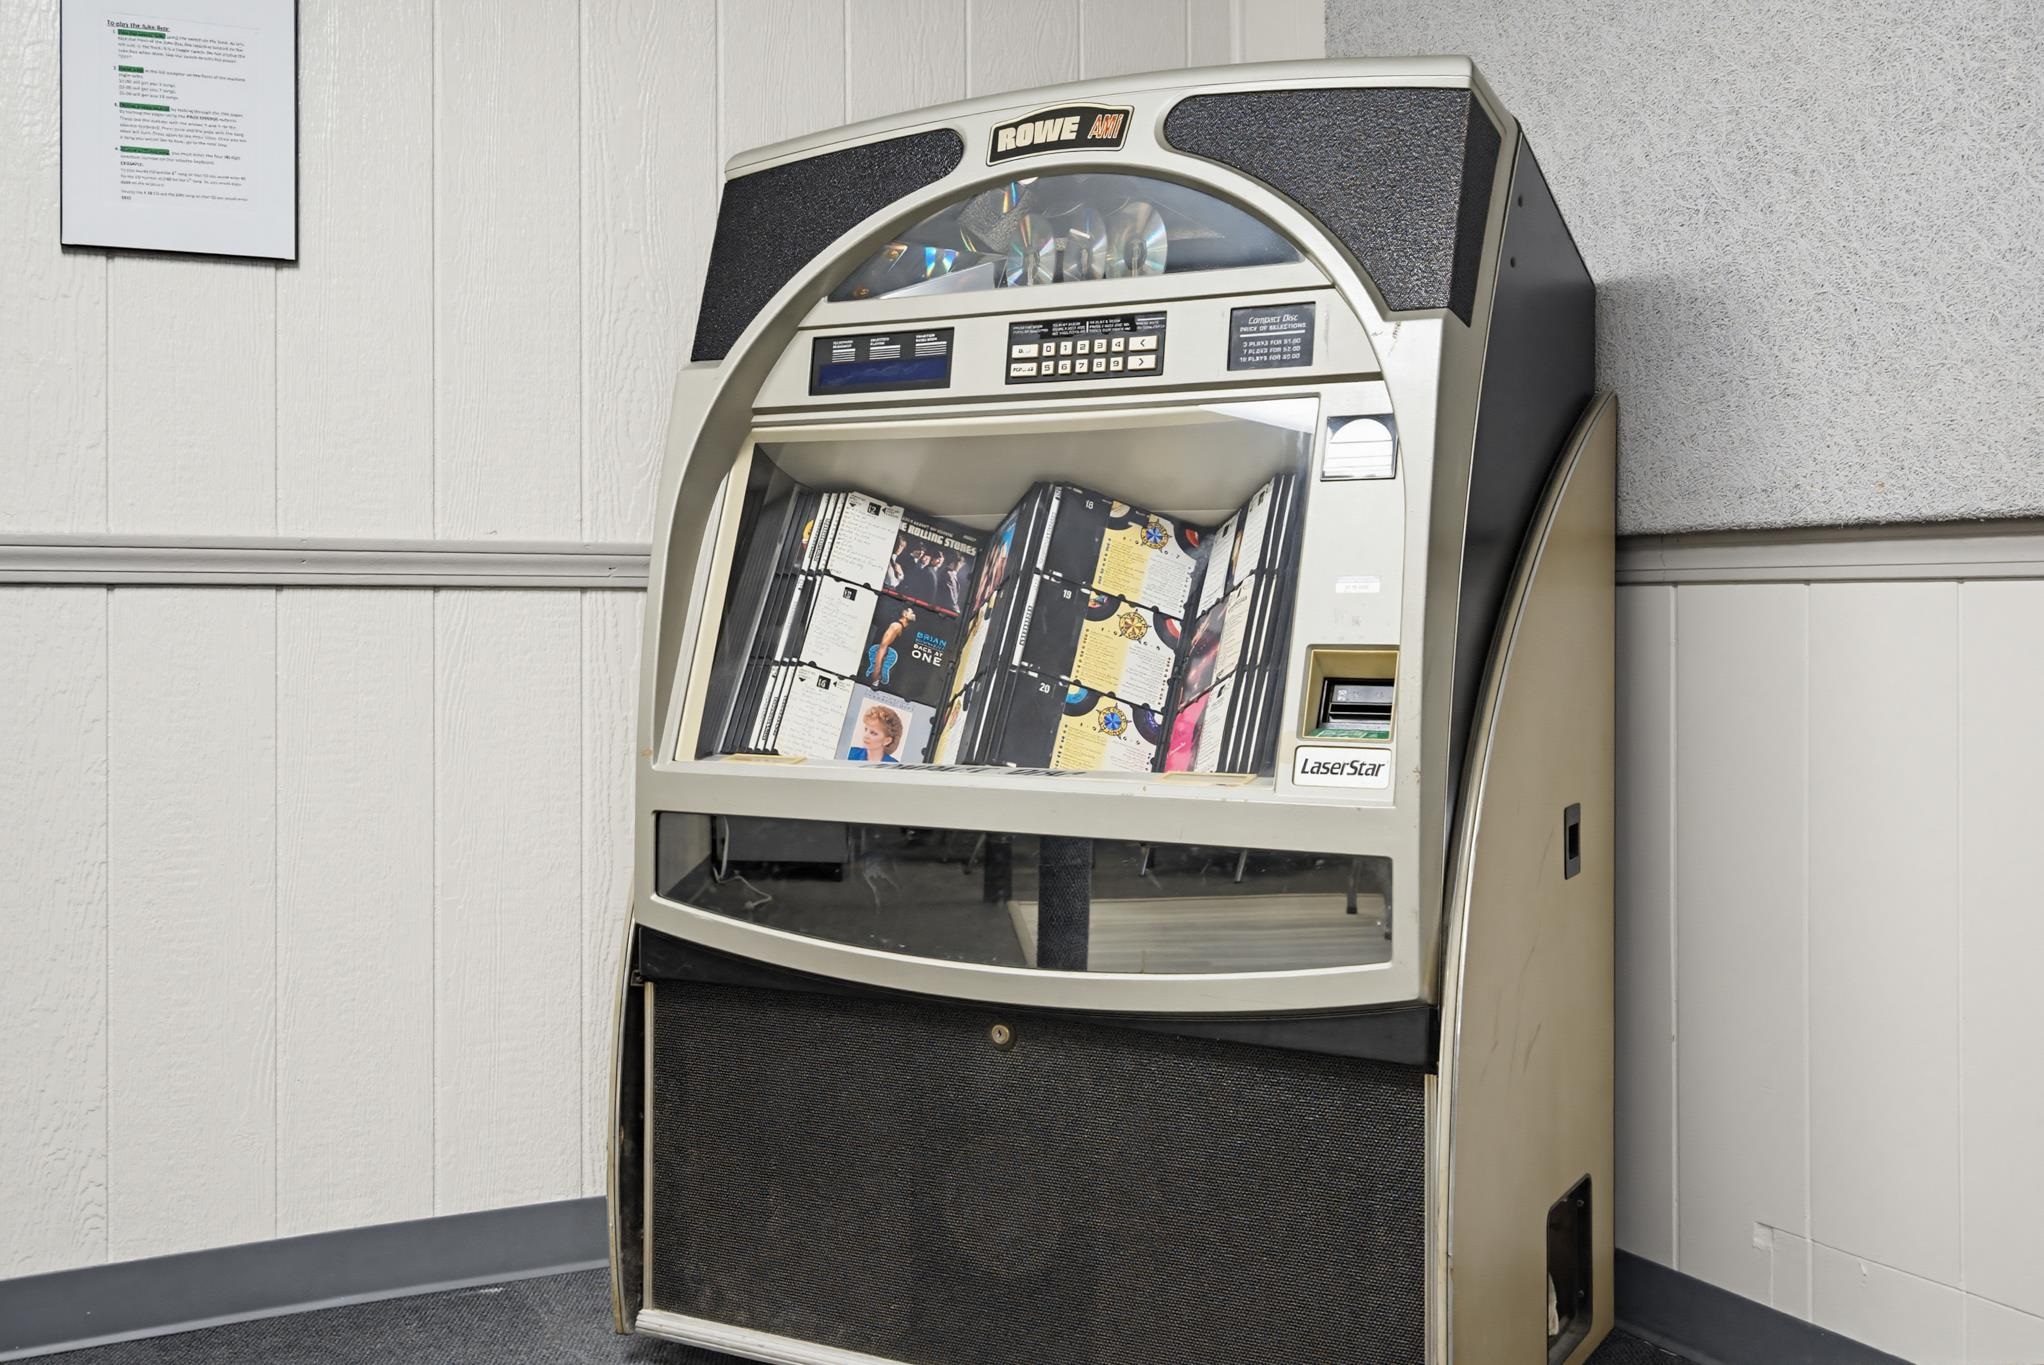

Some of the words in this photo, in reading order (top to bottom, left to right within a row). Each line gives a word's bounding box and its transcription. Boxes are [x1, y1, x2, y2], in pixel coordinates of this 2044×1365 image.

[997, 116, 1080, 152] ROWE
[1045, 345, 1052, 353] 0
[1079, 343, 1086, 351] 2
[1044, 364, 1051, 372] 5
[1061, 363, 1068, 371] 6
[1085, 499, 1094, 510] 18
[907, 524, 944, 546] ROLLING
[944, 537, 977, 557] STONES
[1063, 589, 1072, 600] 19
[916, 631, 947, 648] BRIAN
[911, 649, 942, 667] ONE
[913, 643, 932, 654] BACK
[934, 650, 943, 658] AT
[1039, 682, 1051, 694] 20
[1300, 758, 1386, 778] LaserStar
